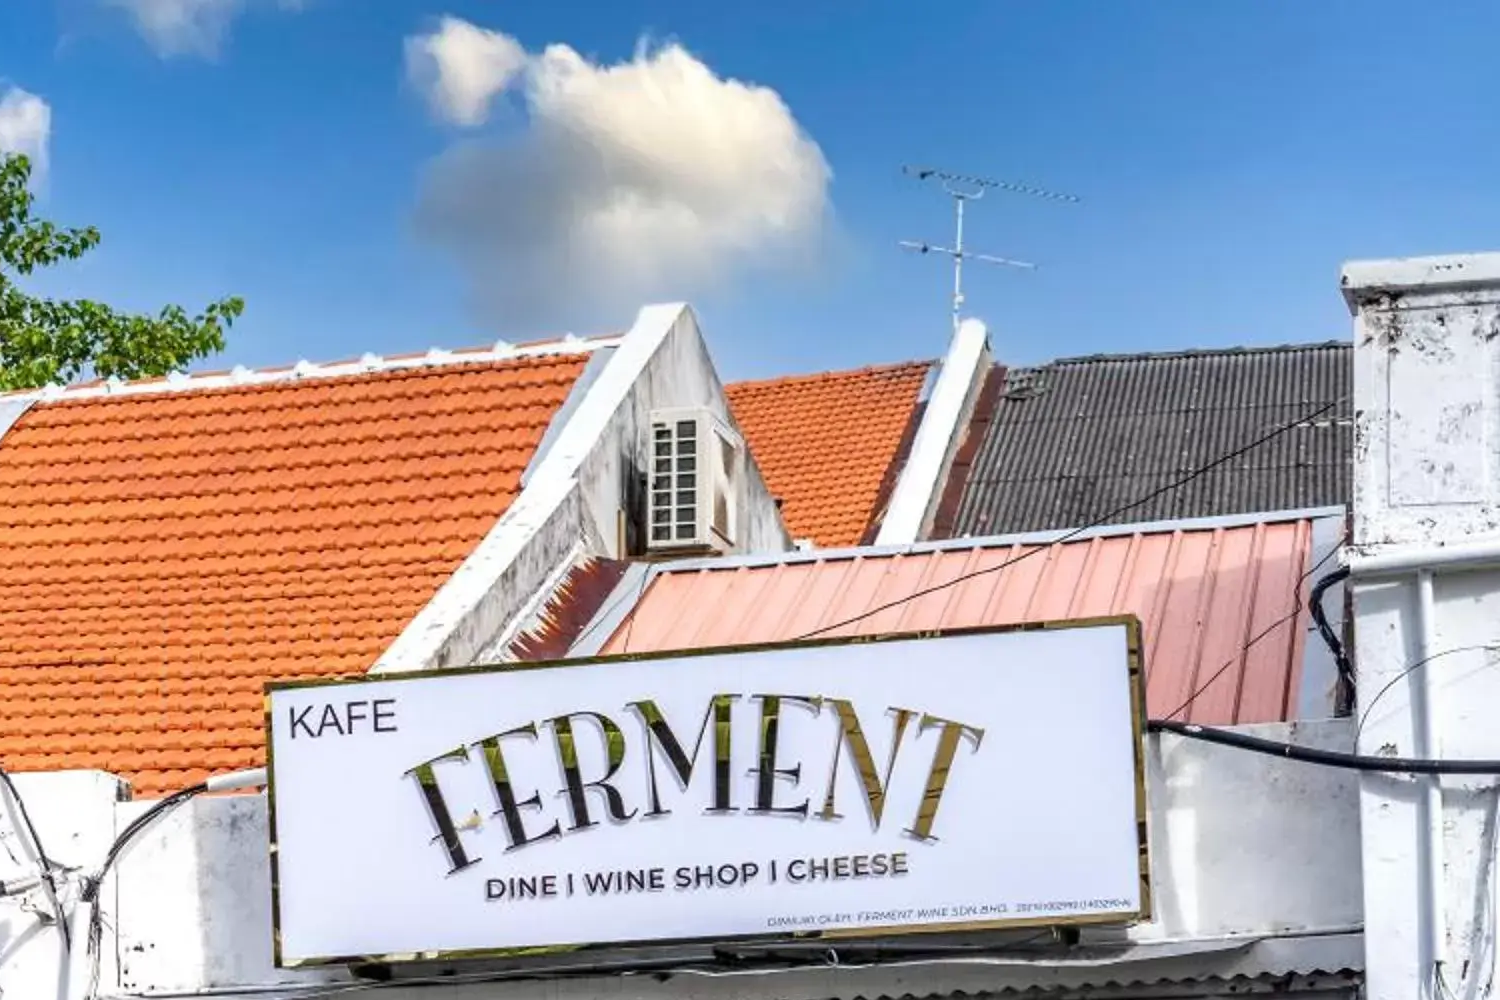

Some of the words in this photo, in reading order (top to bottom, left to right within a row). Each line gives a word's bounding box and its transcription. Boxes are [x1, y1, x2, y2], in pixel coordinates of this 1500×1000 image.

[289, 699, 397, 739] KAFE
[403, 693, 985, 877] FERMENT
[486, 875, 557, 900] DINE
[584, 868, 665, 896] WINE
[674, 862, 759, 889] SHOP
[788, 853, 909, 881] CHEESE
